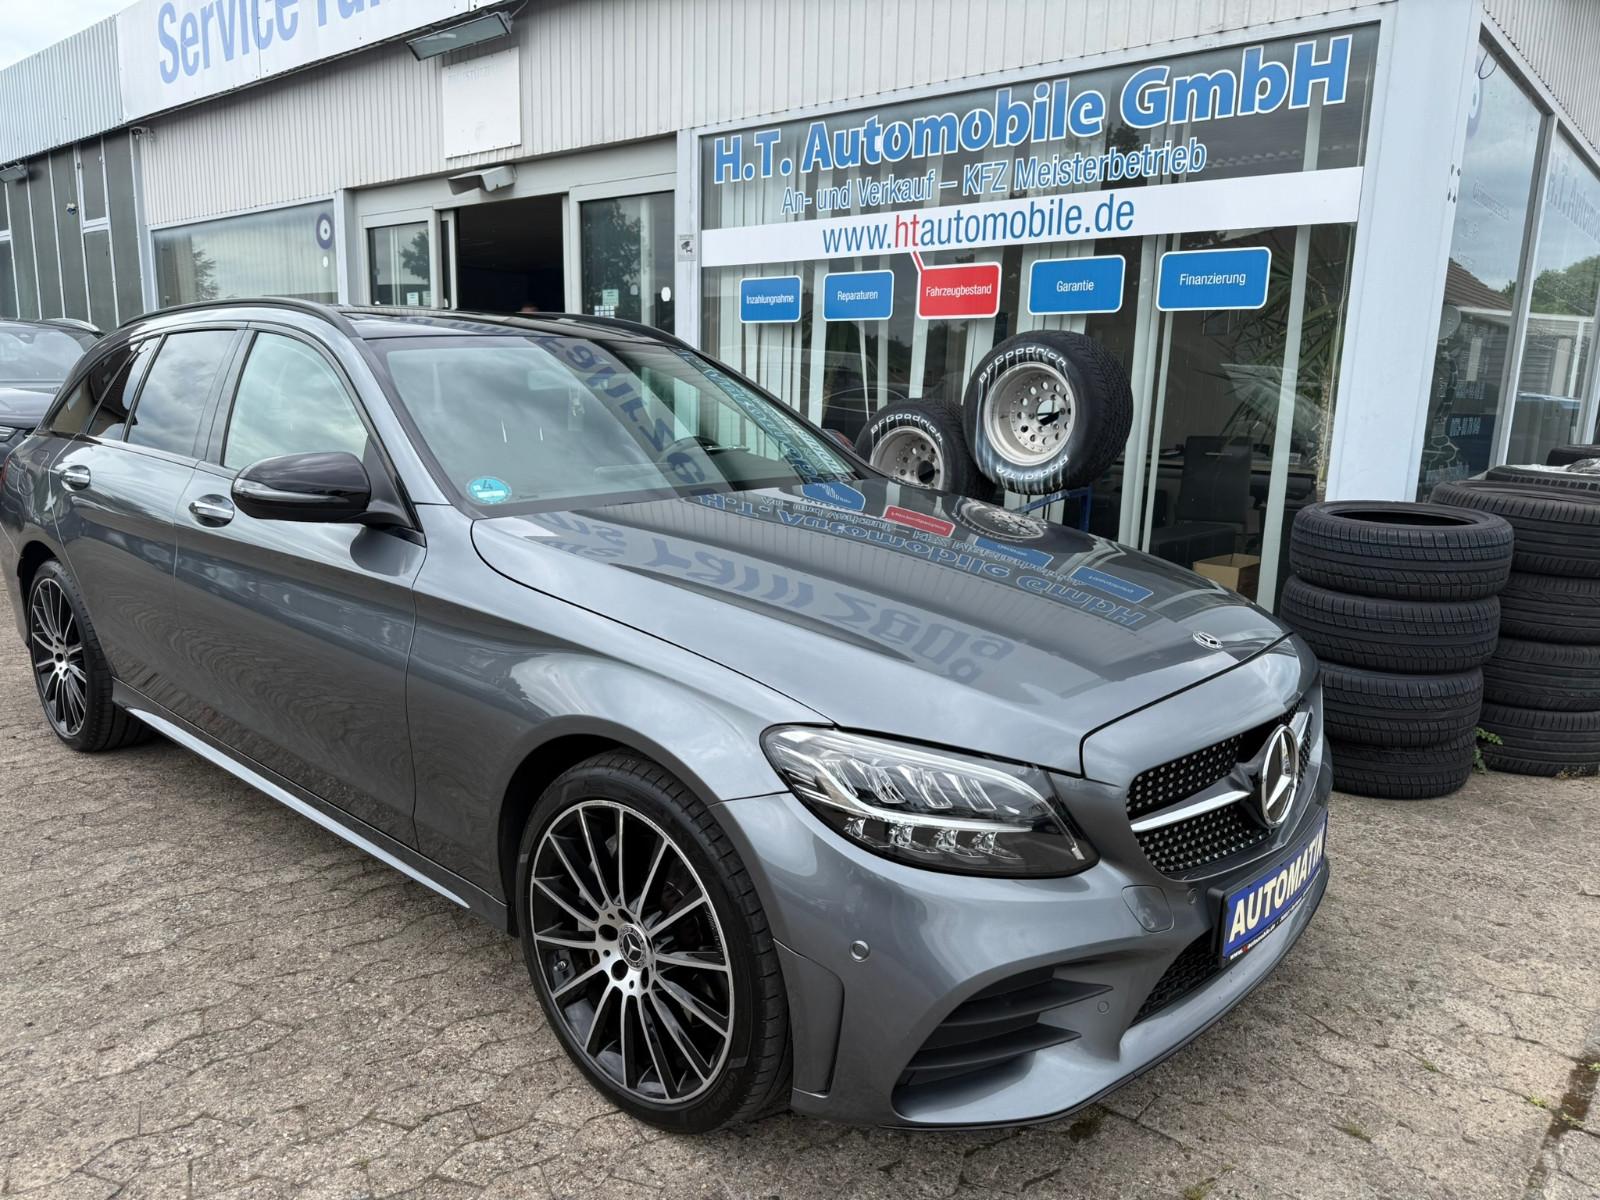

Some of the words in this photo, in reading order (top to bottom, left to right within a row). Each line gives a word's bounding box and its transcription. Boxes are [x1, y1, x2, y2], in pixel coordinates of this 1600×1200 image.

[158, 0, 299, 84] Service
[713, 128, 793, 184] H.T.
[800, 77, 1106, 174] Automobile
[1119, 34, 1353, 129] GmbH
[780, 186, 812, 215] An-
[816, 179, 852, 212] und
[857, 169, 937, 207] Verkauf
[962, 160, 1010, 197] KFZ
[1013, 136, 1207, 192] Meisterbetrieb
[822, 193, 1135, 254] www.htautomobile.de
[925, 284, 992, 298] Fahrzeugbestand
[1056, 279, 1095, 293] Garantie
[1179, 272, 1246, 287] Finanzierung
[746, 293, 795, 306] Inzahlungnahme
[837, 289, 879, 302] Reparaturen
[979, 345, 1066, 384] BFGoodrich
[870, 413, 943, 442] BFGoodrich
